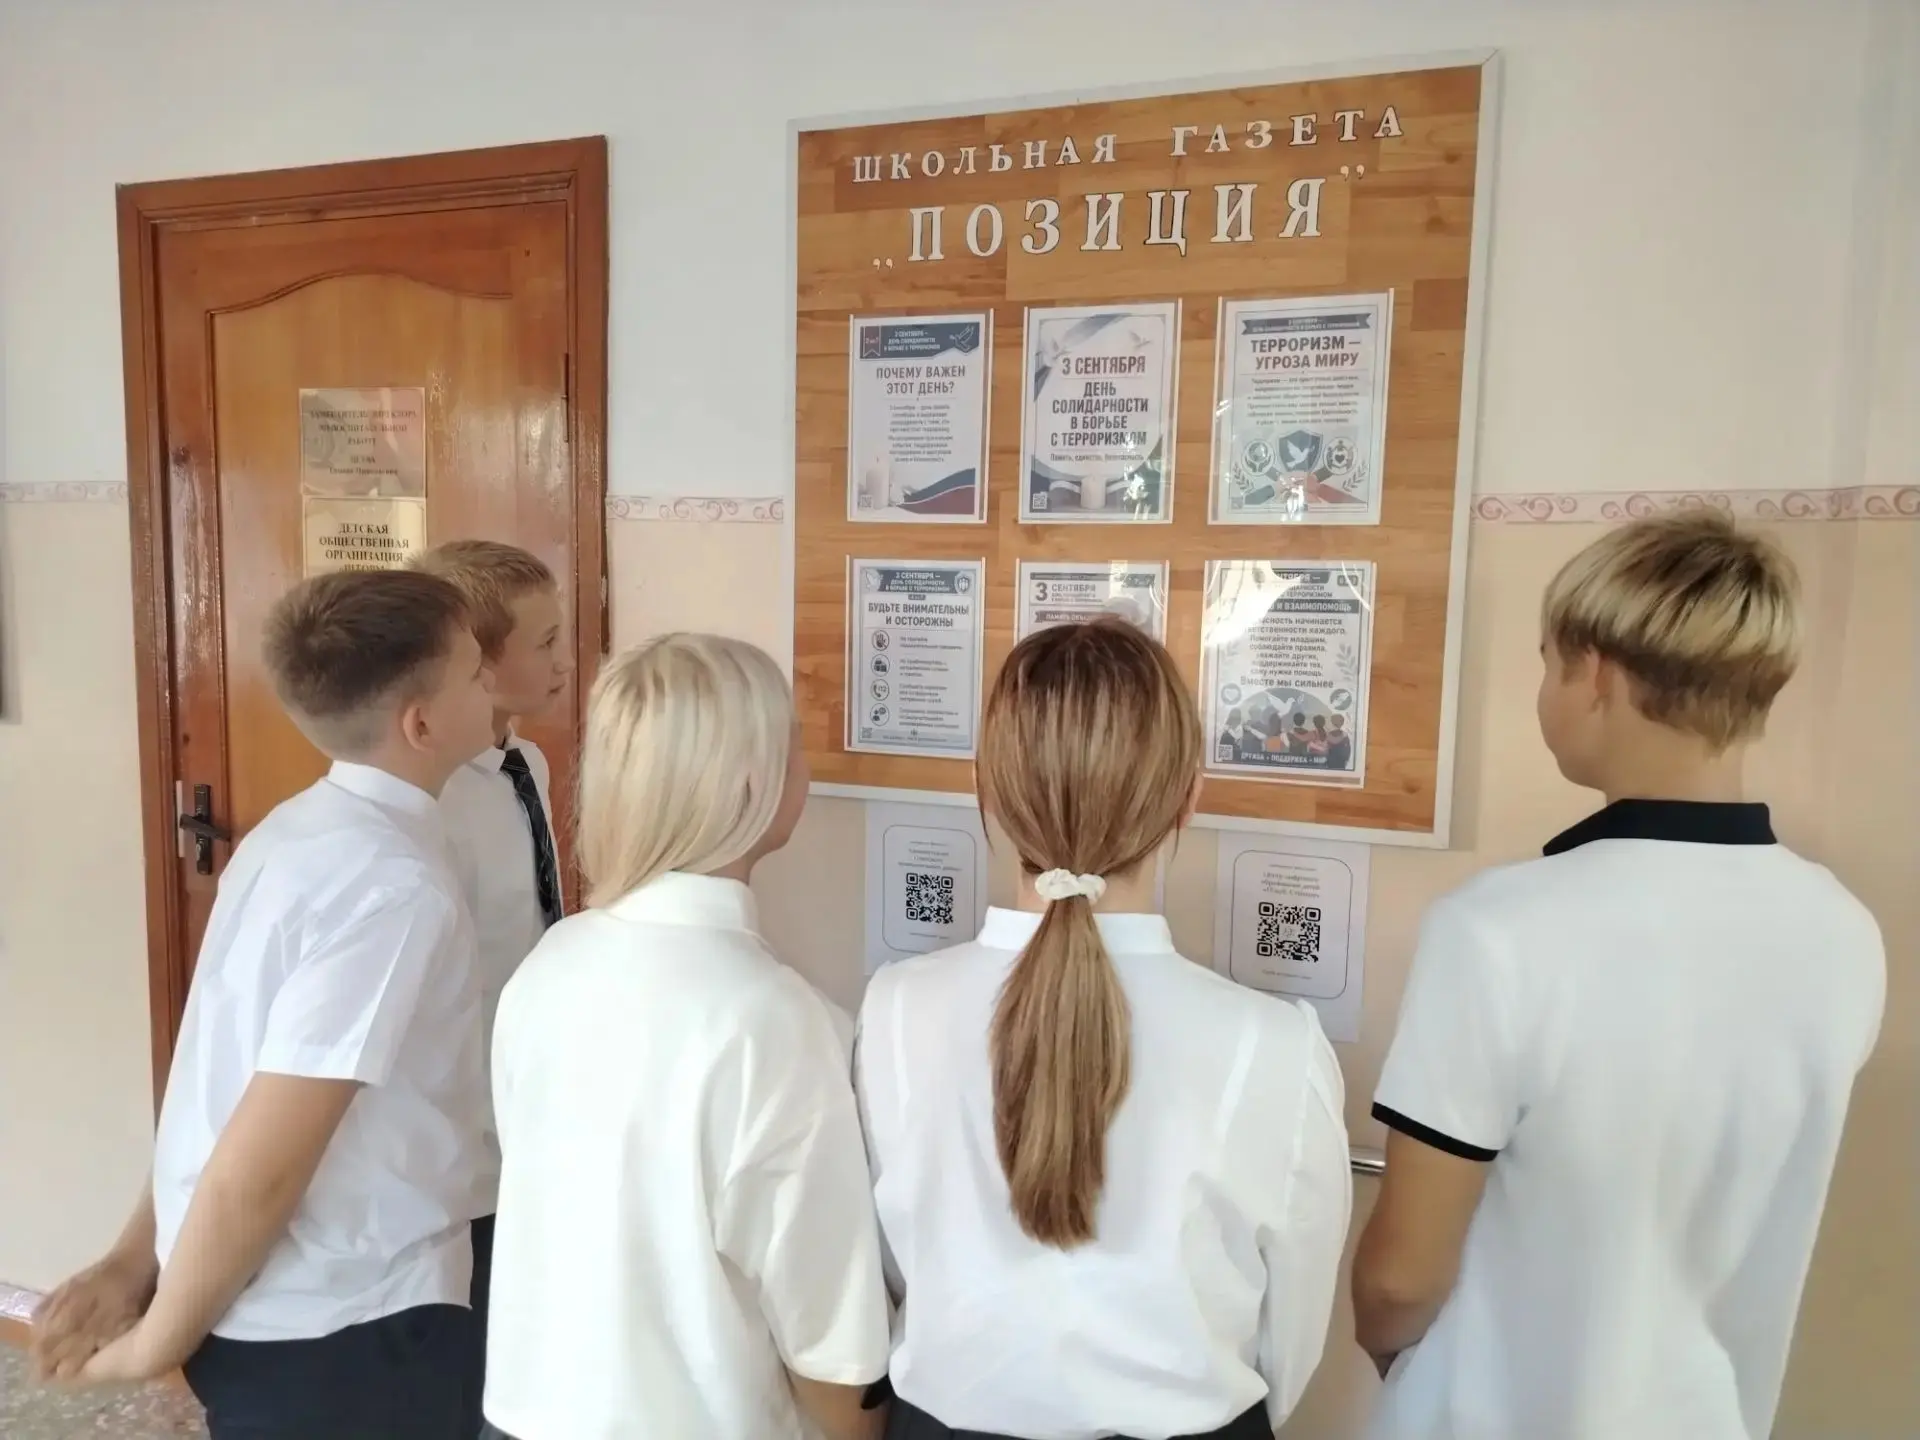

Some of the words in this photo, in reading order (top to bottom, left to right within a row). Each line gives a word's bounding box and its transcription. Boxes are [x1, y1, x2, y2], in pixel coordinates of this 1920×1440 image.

[852, 133, 1118, 184] ШКОЛЬНАЯ
[1170, 105, 1404, 156] ГАЗЕТА
[1250, 335, 1345, 353] ТЕРРОРИЗМ
[1062, 358, 1071, 375] 3
[1075, 356, 1146, 375] СЕНТЯБРЯ
[1255, 356, 1311, 370] УГРОЗА
[1315, 351, 1359, 369] МИРУ
[876, 367, 922, 380] ПОЧЕМУ
[925, 365, 966, 378] ВАЖЕН
[886, 382, 915, 395] ЭТОТ
[918, 381, 955, 397] ДЕНЬ?
[1083, 382, 1117, 398] ДЕНЬ
[1052, 398, 1149, 414] СОЛИДАРНОСТИ
[1070, 417, 1078, 430] В
[1082, 415, 1128, 430] БОРЬБЕ
[1050, 433, 1058, 447] С
[339, 523, 389, 535] ДЕТСКАЯ
[319, 536, 409, 549] ОБЩЕСТВЕННАЯ
[325, 549, 403, 563] ОРГАНИЗАЦИЯ
[1035, 582, 1048, 602] 3
[1051, 583, 1096, 593] СЕНТЯБРЯ
[868, 602, 900, 614] БУДЬТЕ
[902, 603, 969, 615] ВНИМАТЕЛЬНЫ
[1284, 602, 1352, 612] ВЗАИМОПОМОЩЬ
[886, 616, 892, 625] И
[894, 616, 953, 627] ОСТОРОЖНЫ
[1277, 679, 1292, 687] мы
[1294, 680, 1334, 689] сильнее
